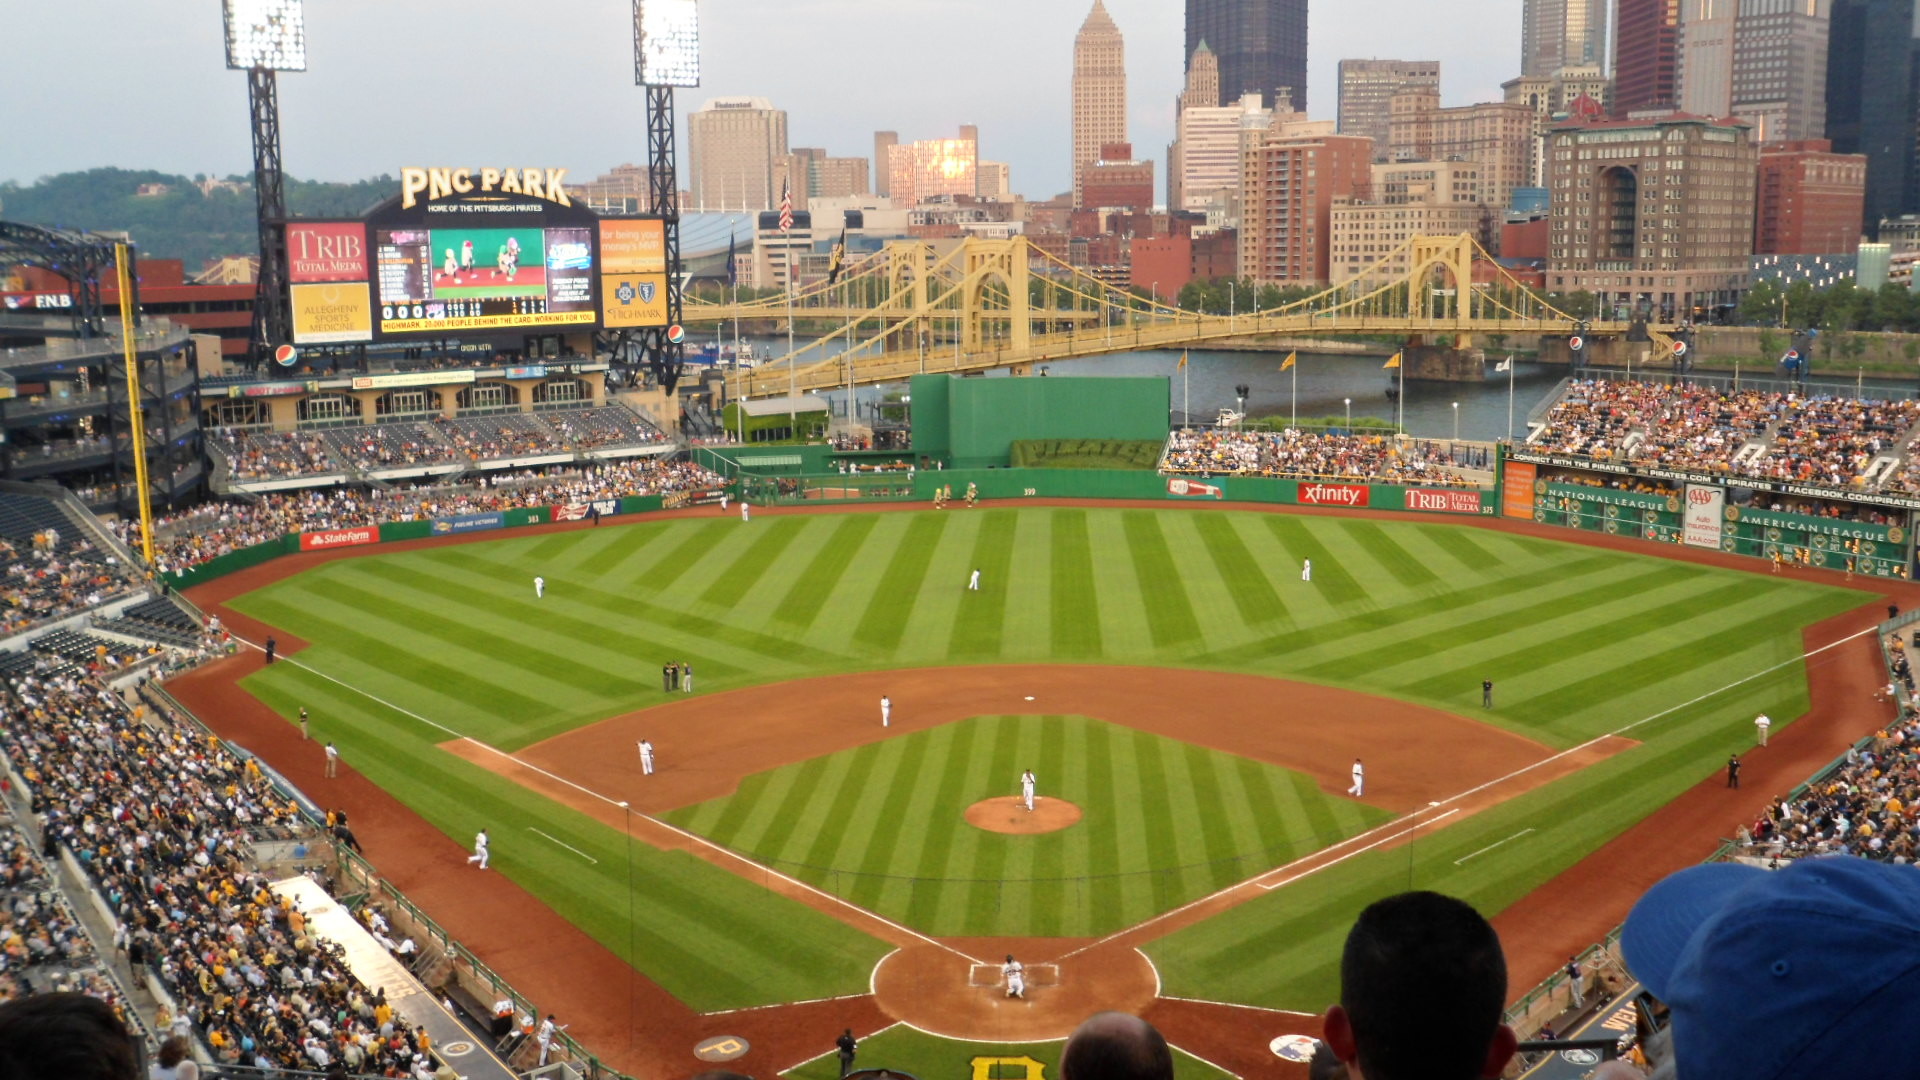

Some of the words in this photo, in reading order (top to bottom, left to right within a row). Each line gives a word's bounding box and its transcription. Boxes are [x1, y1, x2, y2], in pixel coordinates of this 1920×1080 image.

[714, 101, 752, 109] Federated
[400, 166, 475, 210] PNC
[480, 166, 572, 208] PARK
[428, 204, 448, 213] HOME
[449, 204, 458, 212] OF
[460, 204, 473, 212] THE
[474, 204, 516, 212] PITTSBURGH
[517, 204, 543, 212] PIRATES
[291, 230, 361, 259] TRIB
[293, 260, 329, 273] TOTAL
[330, 260, 362, 272] MEDIA
[304, 304, 360, 315] ALLEGHENY
[314, 314, 350, 323] SPORTS
[447, 319, 471, 327] PEOPLE
[474, 317, 498, 326] BEHIND
[535, 314, 564, 323] WORKING
[566, 313, 578, 321] FOR
[309, 322, 356, 333] MEDICINE
[1513, 453, 1551, 465] CONNECT
[1552, 457, 1573, 467] WITH
[1575, 460, 1590, 469] THE
[1650, 470, 1711, 483] PIRATES.COM
[1726, 479, 1772, 490] @PIRATES
[1023, 488, 1036, 496] 399
[1304, 484, 1361, 505] xfinity
[1449, 492, 1479, 503] TOTAL
[1405, 490, 1446, 509] TRIB
[1548, 489, 1610, 504] NATIONAL
[1614, 497, 1664, 512] LEAGUE
[1450, 501, 1480, 512] MEDIA
[1482, 506, 1493, 515] 375
[1740, 515, 1819, 533] AMERICAN
[1823, 525, 1885, 542] LEAGUE
[1687, 535, 1718, 545] AAA.com
